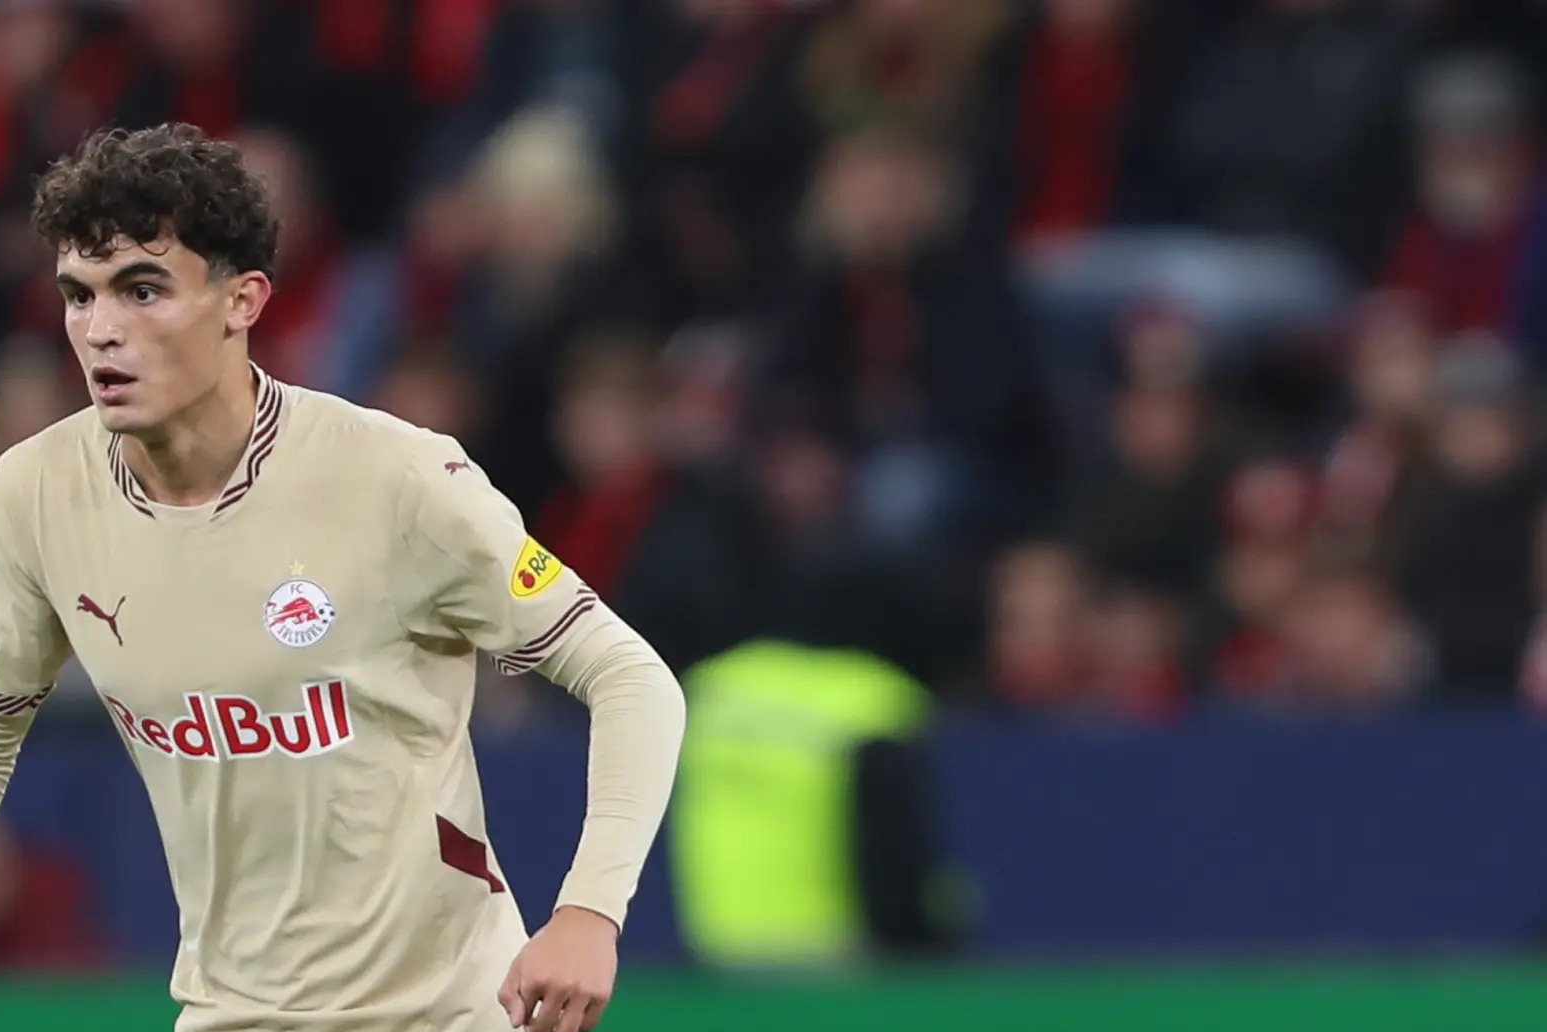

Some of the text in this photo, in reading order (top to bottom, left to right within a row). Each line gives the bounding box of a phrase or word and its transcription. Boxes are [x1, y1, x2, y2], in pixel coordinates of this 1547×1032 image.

[290, 583, 304, 594] FC
[106, 680, 350, 758] Red Bull
